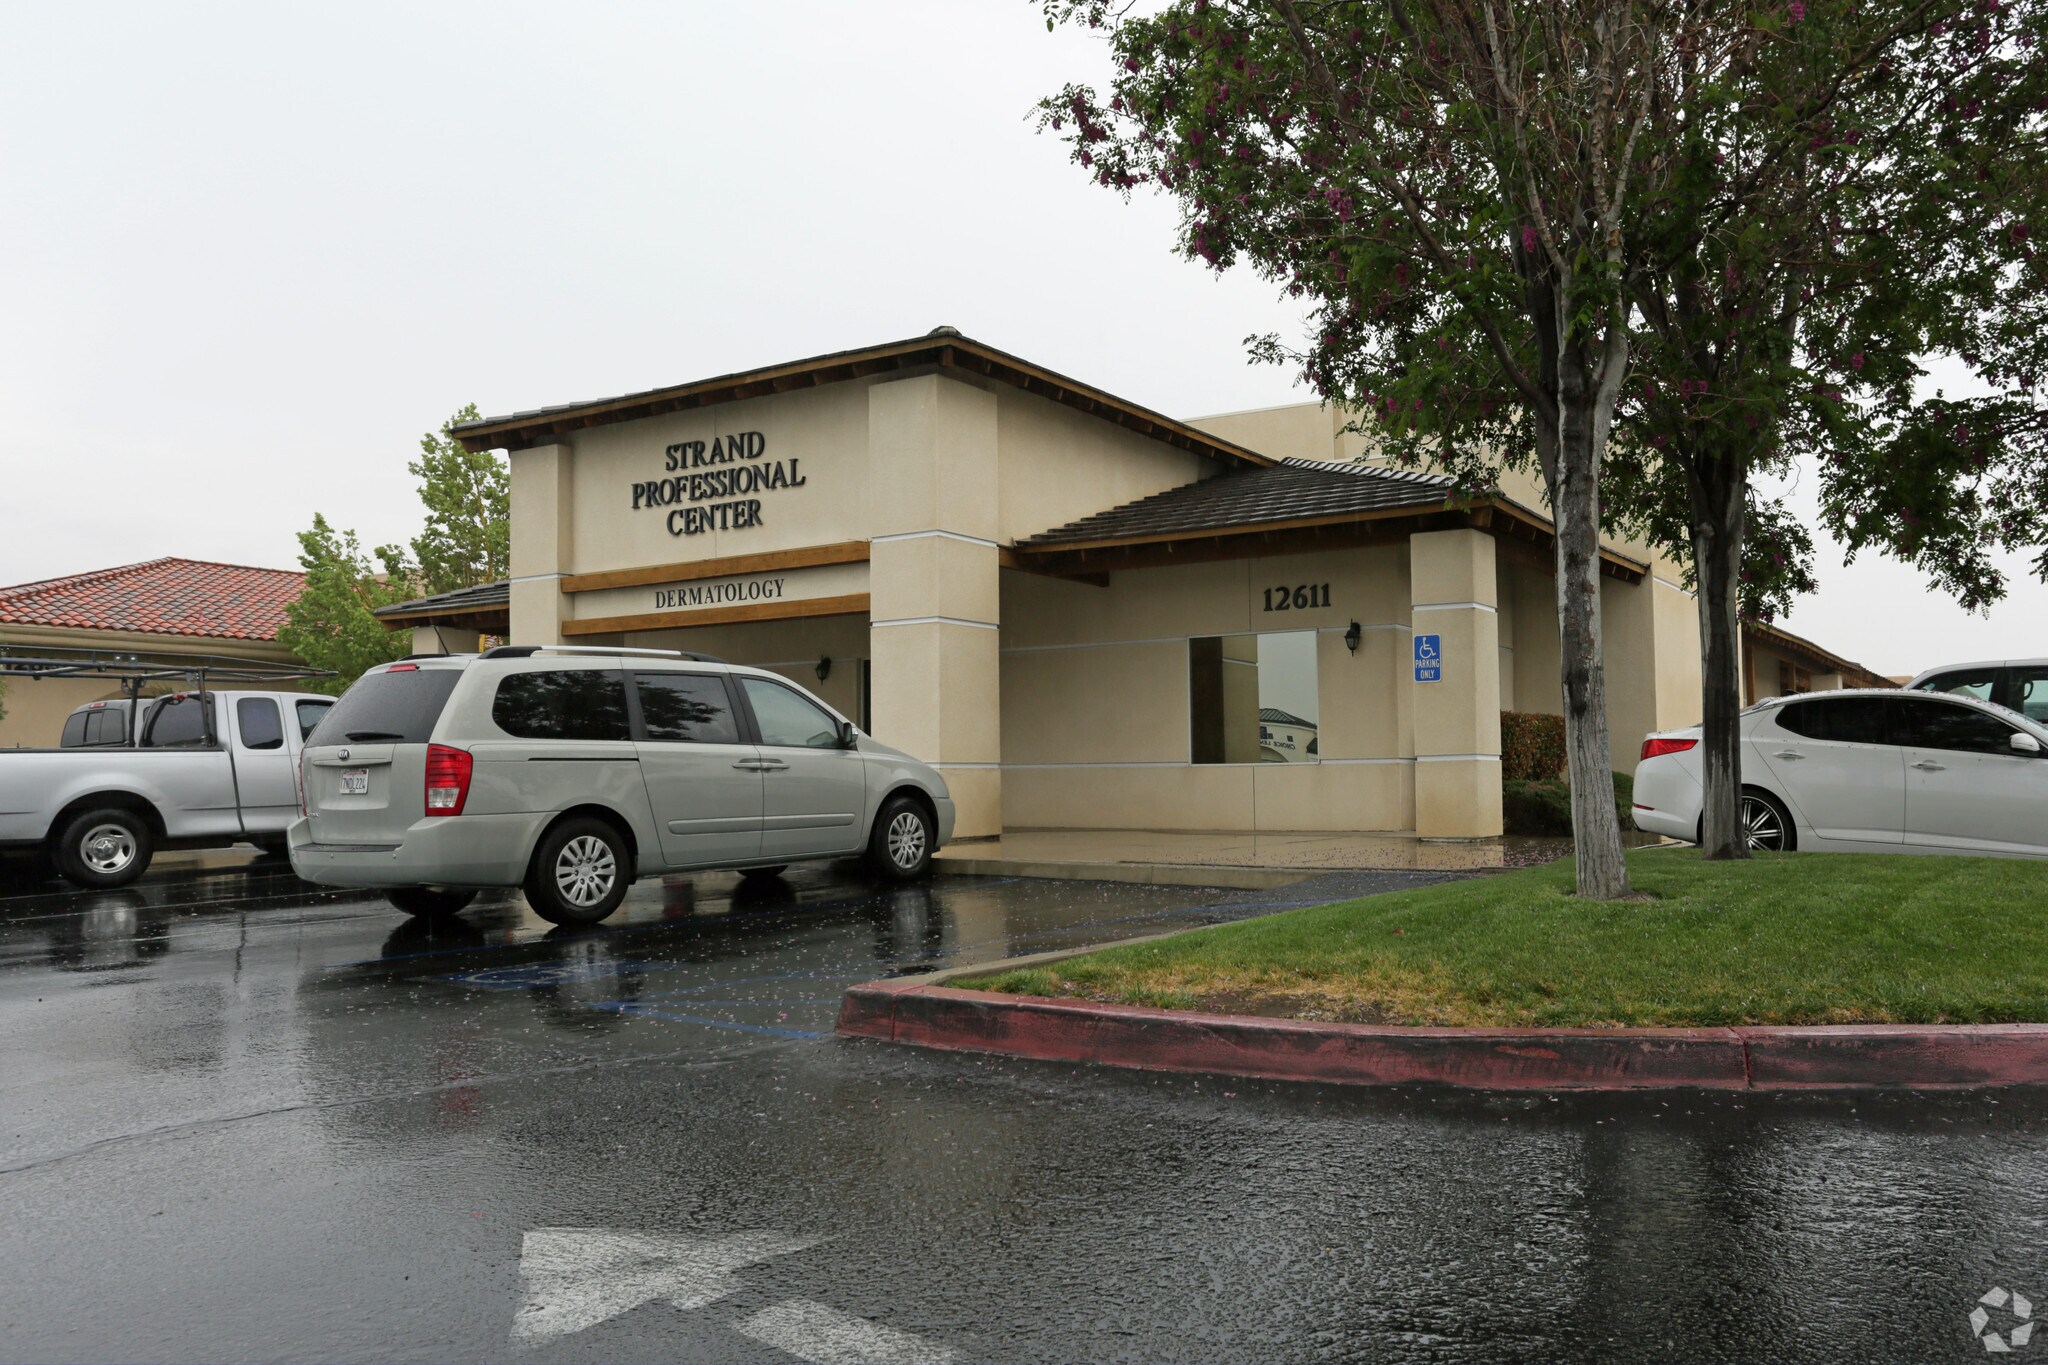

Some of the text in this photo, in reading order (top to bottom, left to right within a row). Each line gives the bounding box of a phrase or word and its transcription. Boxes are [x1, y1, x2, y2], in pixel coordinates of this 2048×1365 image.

[665, 431, 766, 471] STRAND
[631, 458, 806, 510] PROFESSIONAL
[666, 499, 763, 536] CENTER
[655, 579, 785, 609] DERMATOLOGY
[1263, 582, 1331, 611] 12611
[1415, 658, 1440, 669] PARKING
[1420, 669, 1435, 679] ONLY
